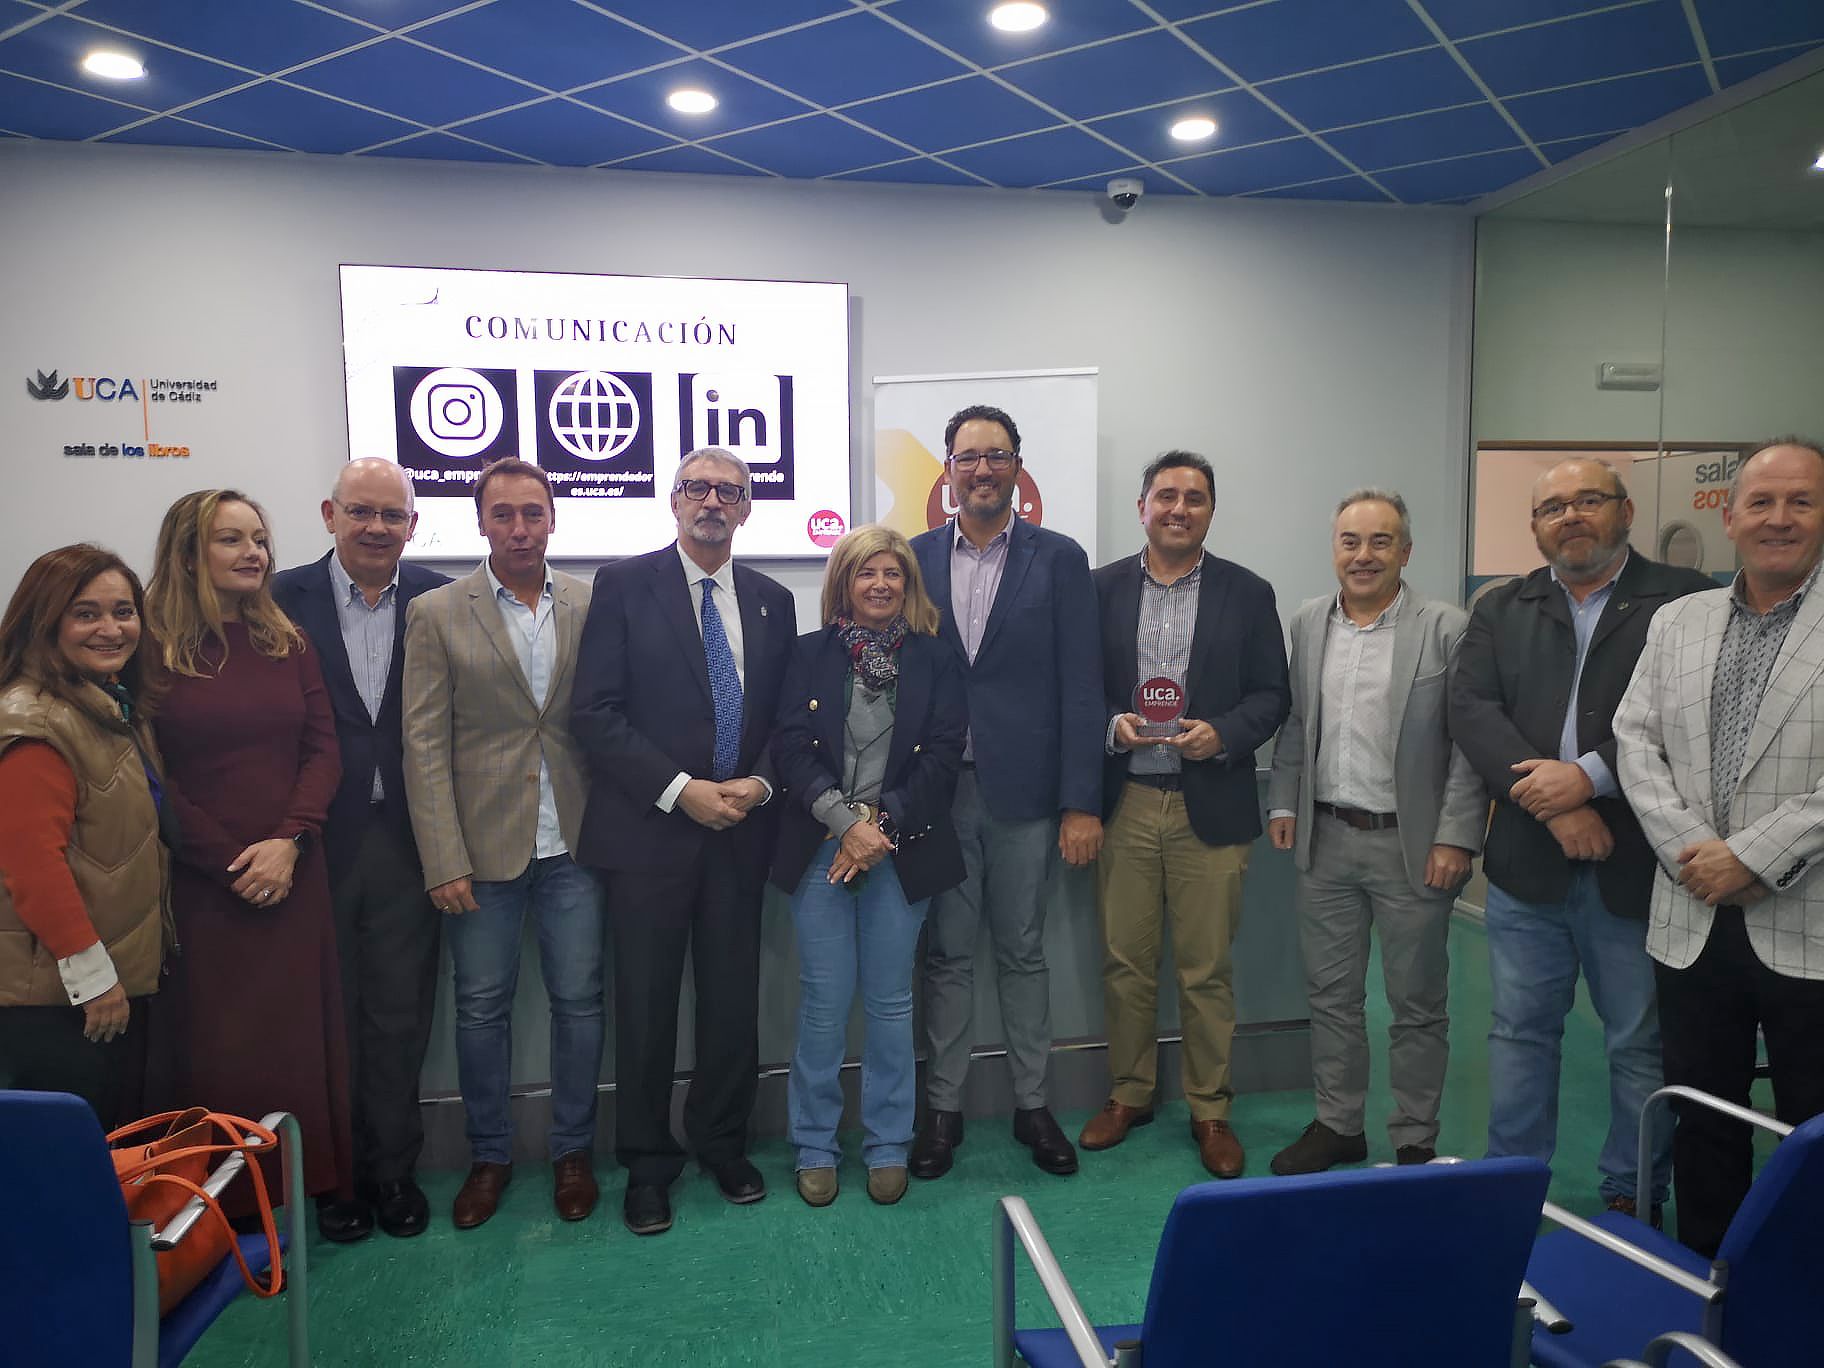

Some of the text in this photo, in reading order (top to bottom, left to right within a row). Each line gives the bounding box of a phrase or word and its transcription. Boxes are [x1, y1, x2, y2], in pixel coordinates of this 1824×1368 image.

[466, 315, 737, 346] COMUNICACIÓN
[72, 377, 139, 401] UCA
[150, 379, 217, 391] Universidad
[151, 391, 201, 402] de Cádiz
[63, 443, 191, 458] sala de los libros
[1143, 687, 1180, 701] uca.
